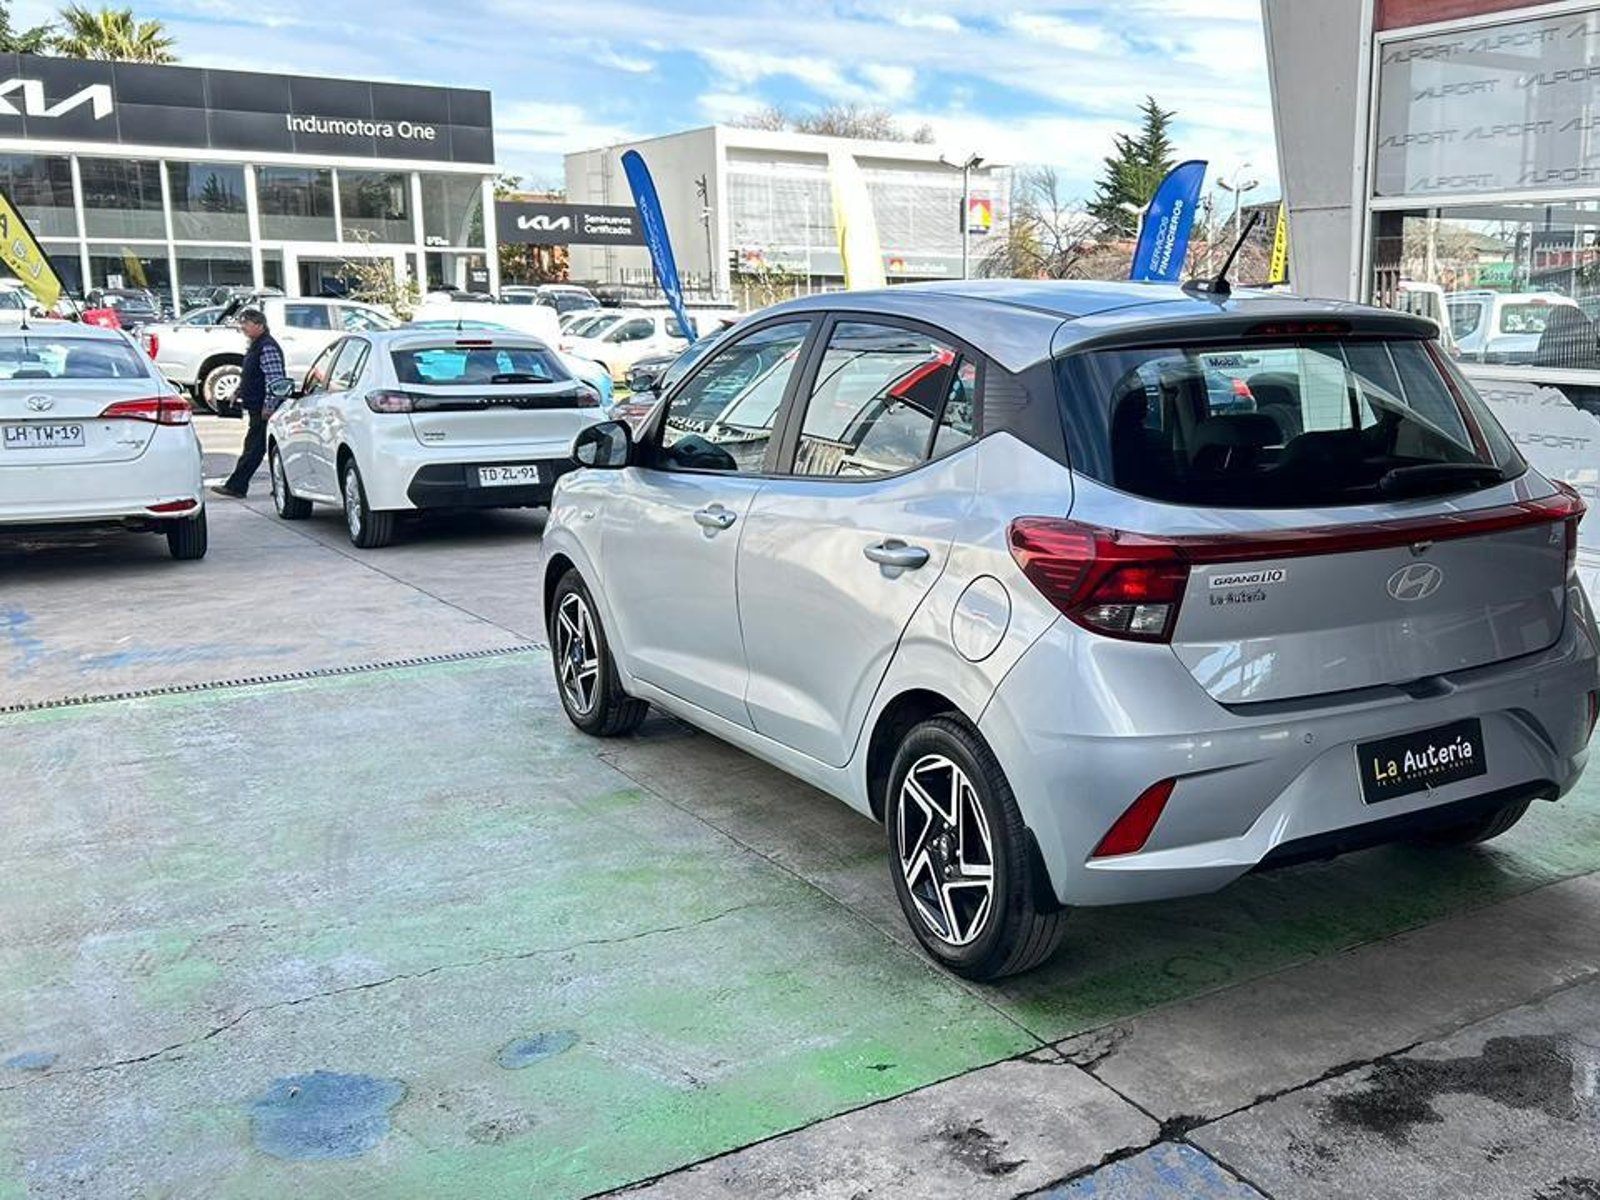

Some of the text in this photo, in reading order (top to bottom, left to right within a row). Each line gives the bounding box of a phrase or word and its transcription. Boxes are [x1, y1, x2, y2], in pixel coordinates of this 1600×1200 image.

[1521, 66, 1600, 88] ALPOR
[0, 78, 113, 120] IA
[286, 114, 436, 140] Indumotora One
[517, 215, 571, 231] KIA
[1158, 199, 1184, 276] FINANCIEROS
[1213, 574, 1261, 586] GRAND
[1373, 757, 1398, 780] La
[1403, 735, 1473, 773] Autería
